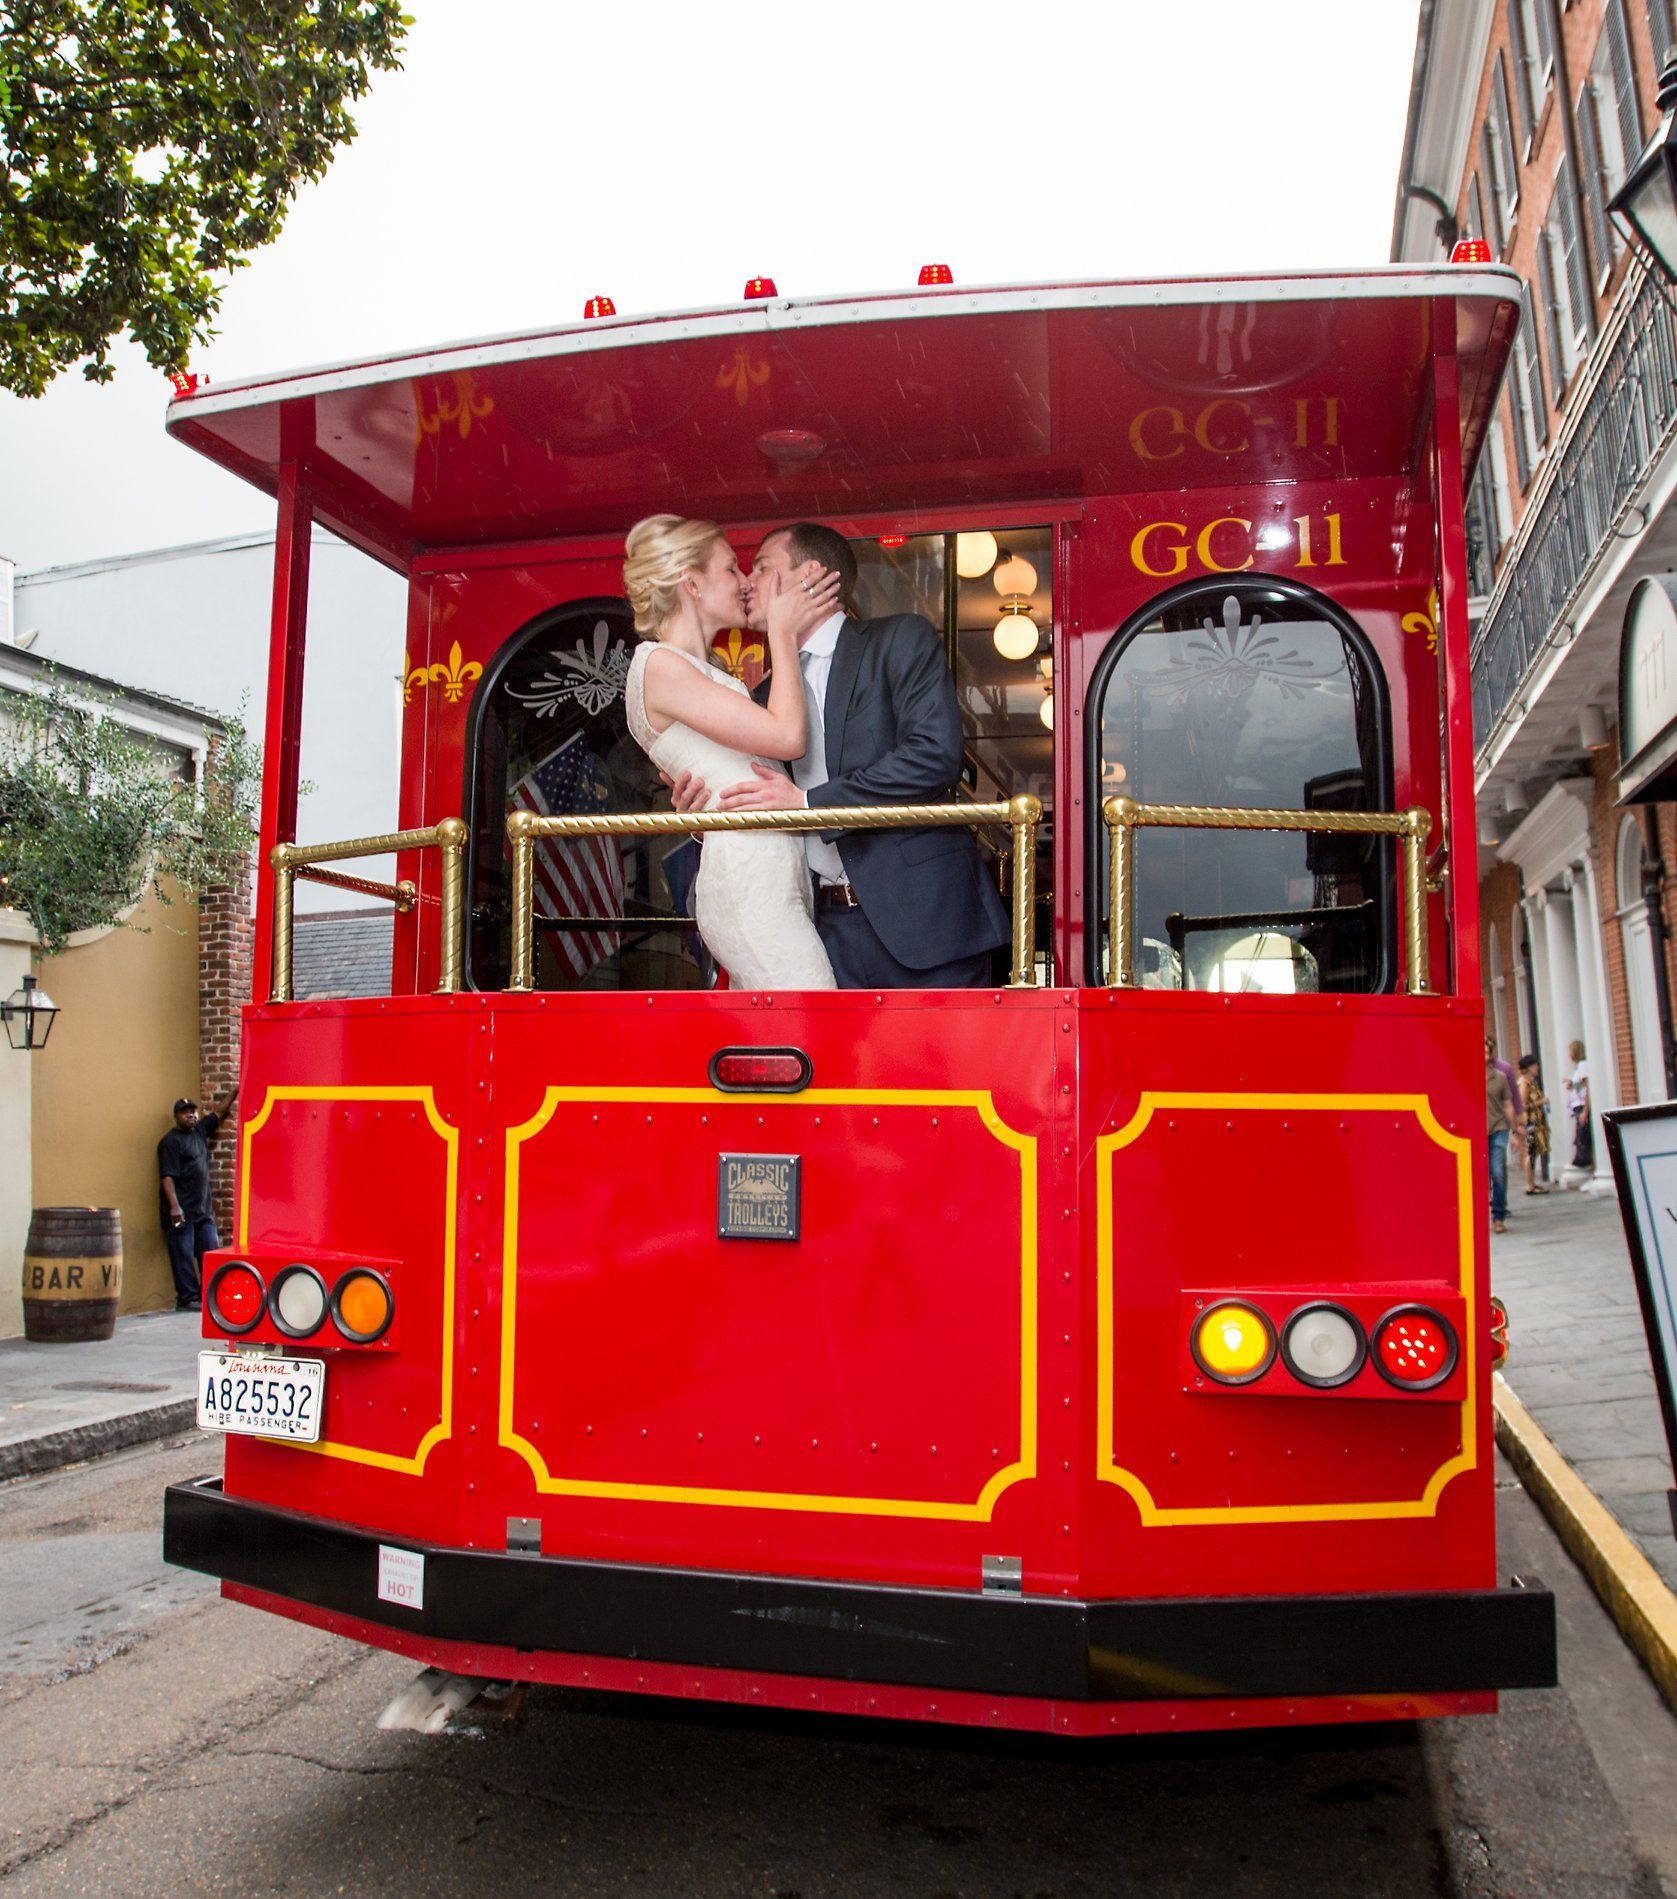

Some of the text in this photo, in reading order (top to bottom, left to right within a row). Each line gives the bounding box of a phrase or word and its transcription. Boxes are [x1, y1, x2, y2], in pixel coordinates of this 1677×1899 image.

[1130, 512, 1348, 577] GC-11
[727, 1162, 789, 1191] CLASSIC
[727, 1202, 788, 1227] TROLLEYS
[31, 1265, 84, 1290] BAR
[205, 1376, 312, 1419] A825532
[239, 1414, 302, 1429] PASSENGER
[382, 1553, 421, 1569] WARNING
[387, 1580, 415, 1600] HOT
